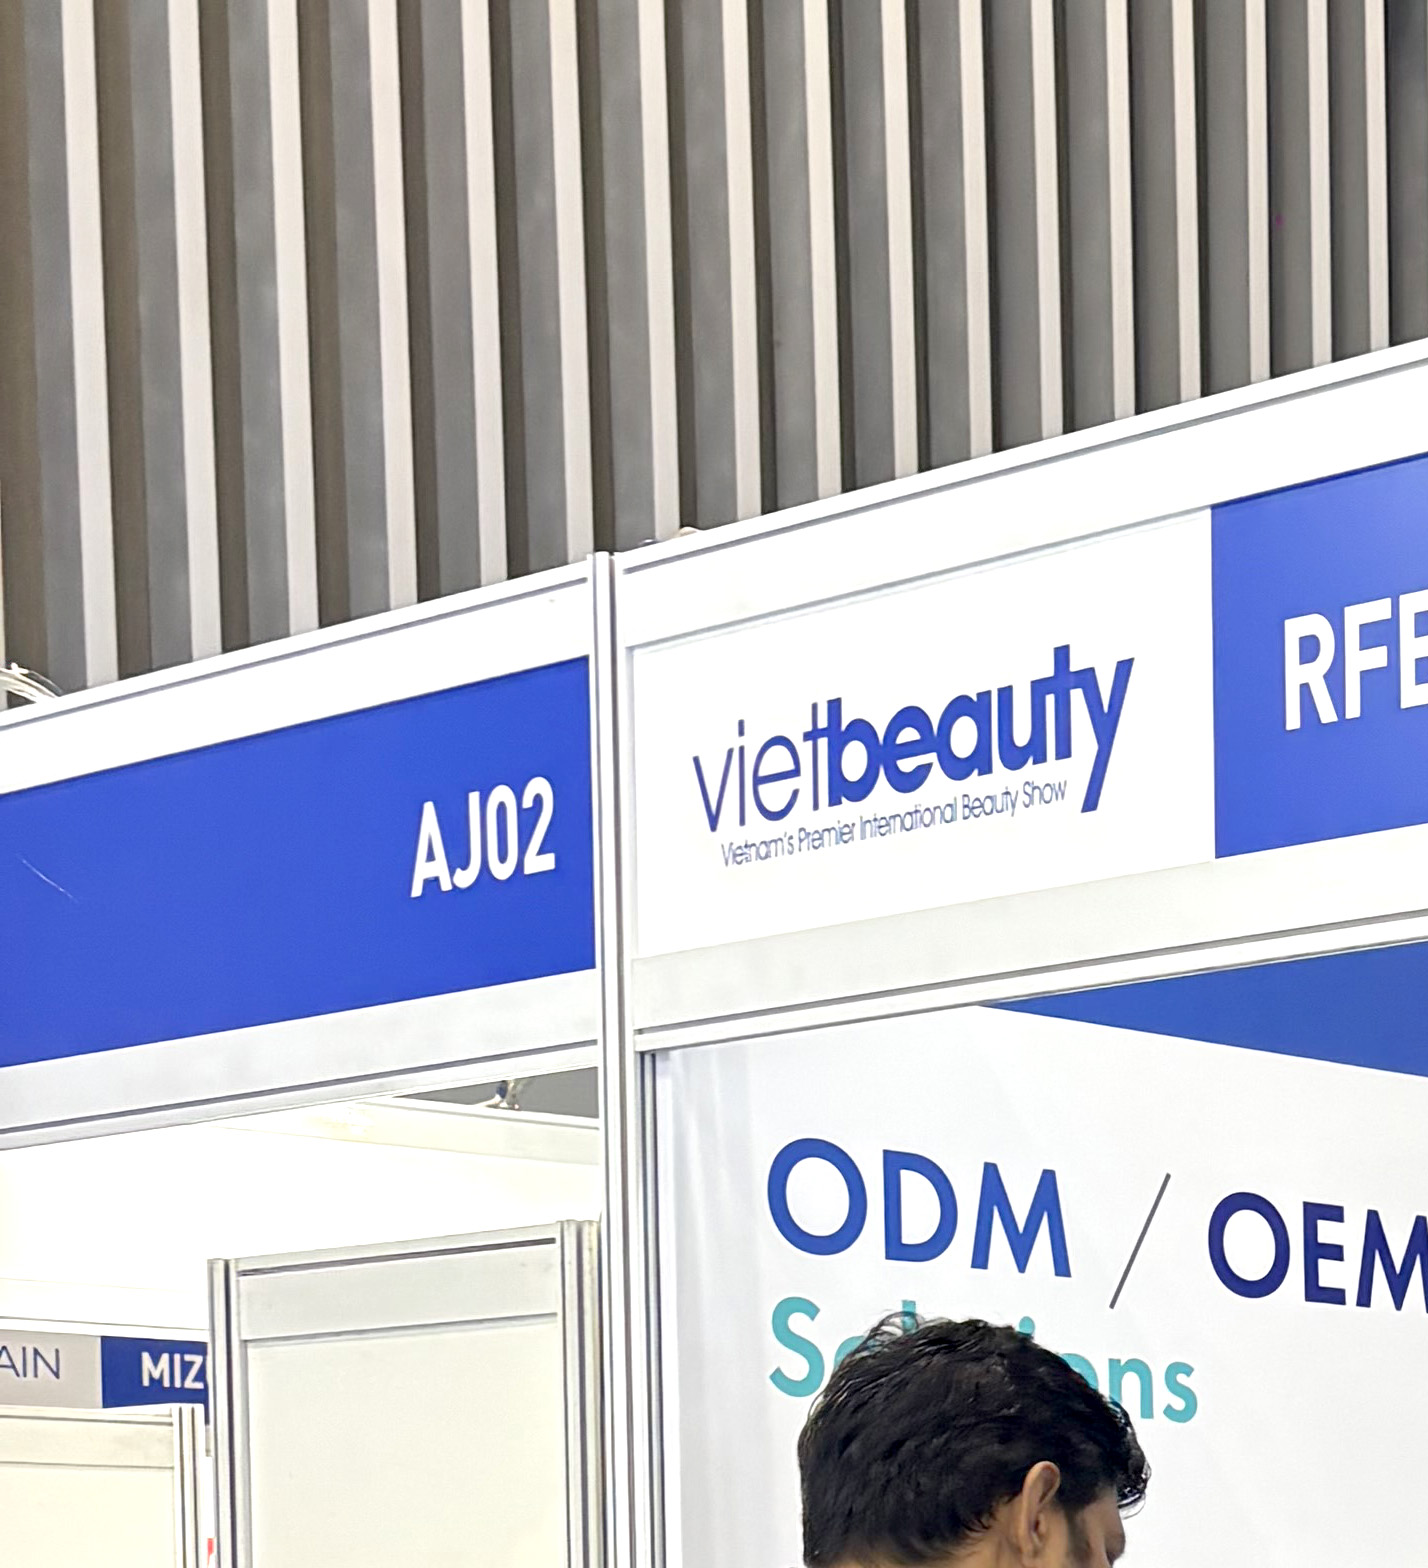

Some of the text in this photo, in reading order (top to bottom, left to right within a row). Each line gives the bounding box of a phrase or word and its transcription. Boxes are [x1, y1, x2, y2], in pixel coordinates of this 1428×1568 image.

[692, 643, 1135, 833] vietbeauty
[410, 776, 557, 898] AJ02
[798, 820, 855, 853] Premier
[859, 796, 958, 842] International
[962, 785, 1018, 822] Beauty
[1022, 780, 1067, 812] Show
[767, 1136, 1072, 1279] ODM
[1109, 1172, 1171, 1310] /
[141, 1351, 205, 1390] MIZ
